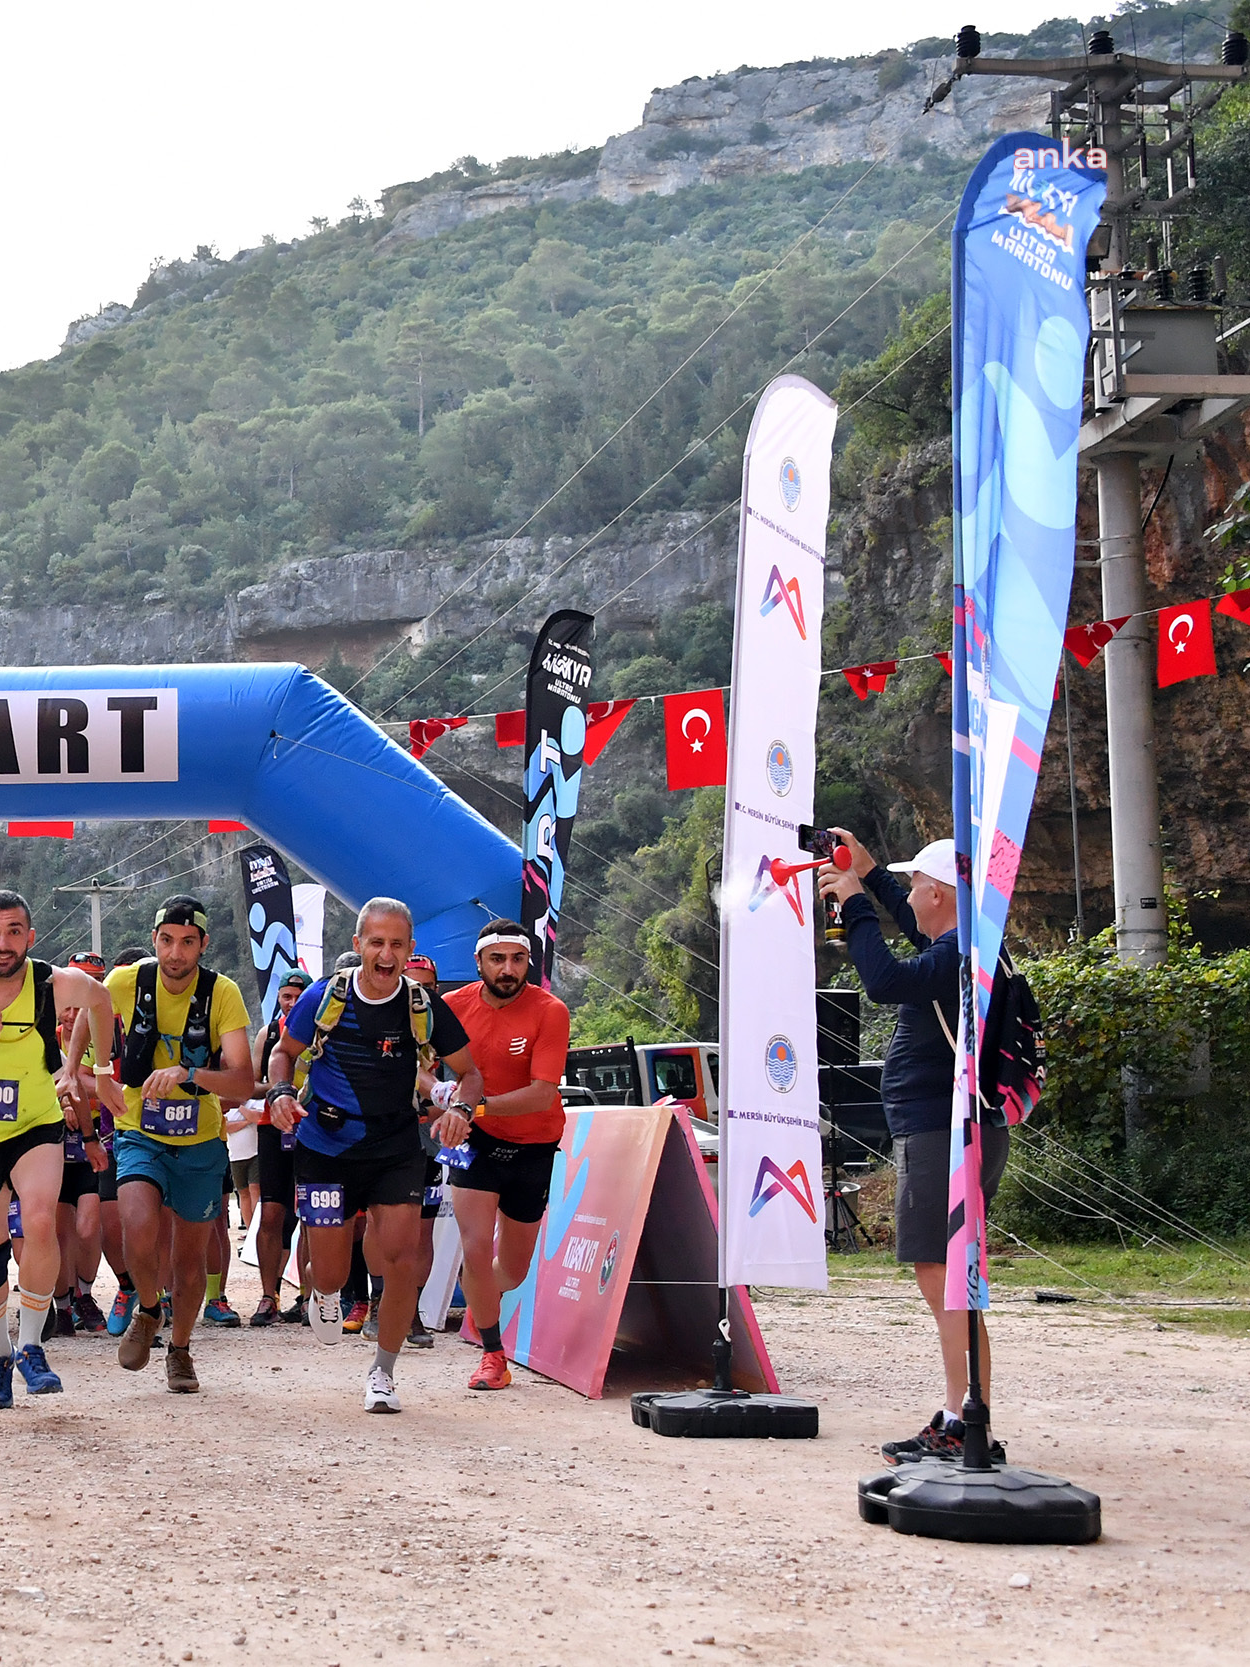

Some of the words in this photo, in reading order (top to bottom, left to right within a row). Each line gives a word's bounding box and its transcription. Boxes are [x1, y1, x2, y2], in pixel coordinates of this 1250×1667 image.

[1009, 226, 1056, 264] ULTRA
[991, 230, 1073, 290] MARATONU
[547, 683, 582, 704] MARATONU
[555, 678, 574, 693] ULTRA
[165, 1105, 192, 1121] 681
[764, 1112, 802, 1127] BÜYÜKŞEHİR
[311, 1191, 340, 1208] 698
